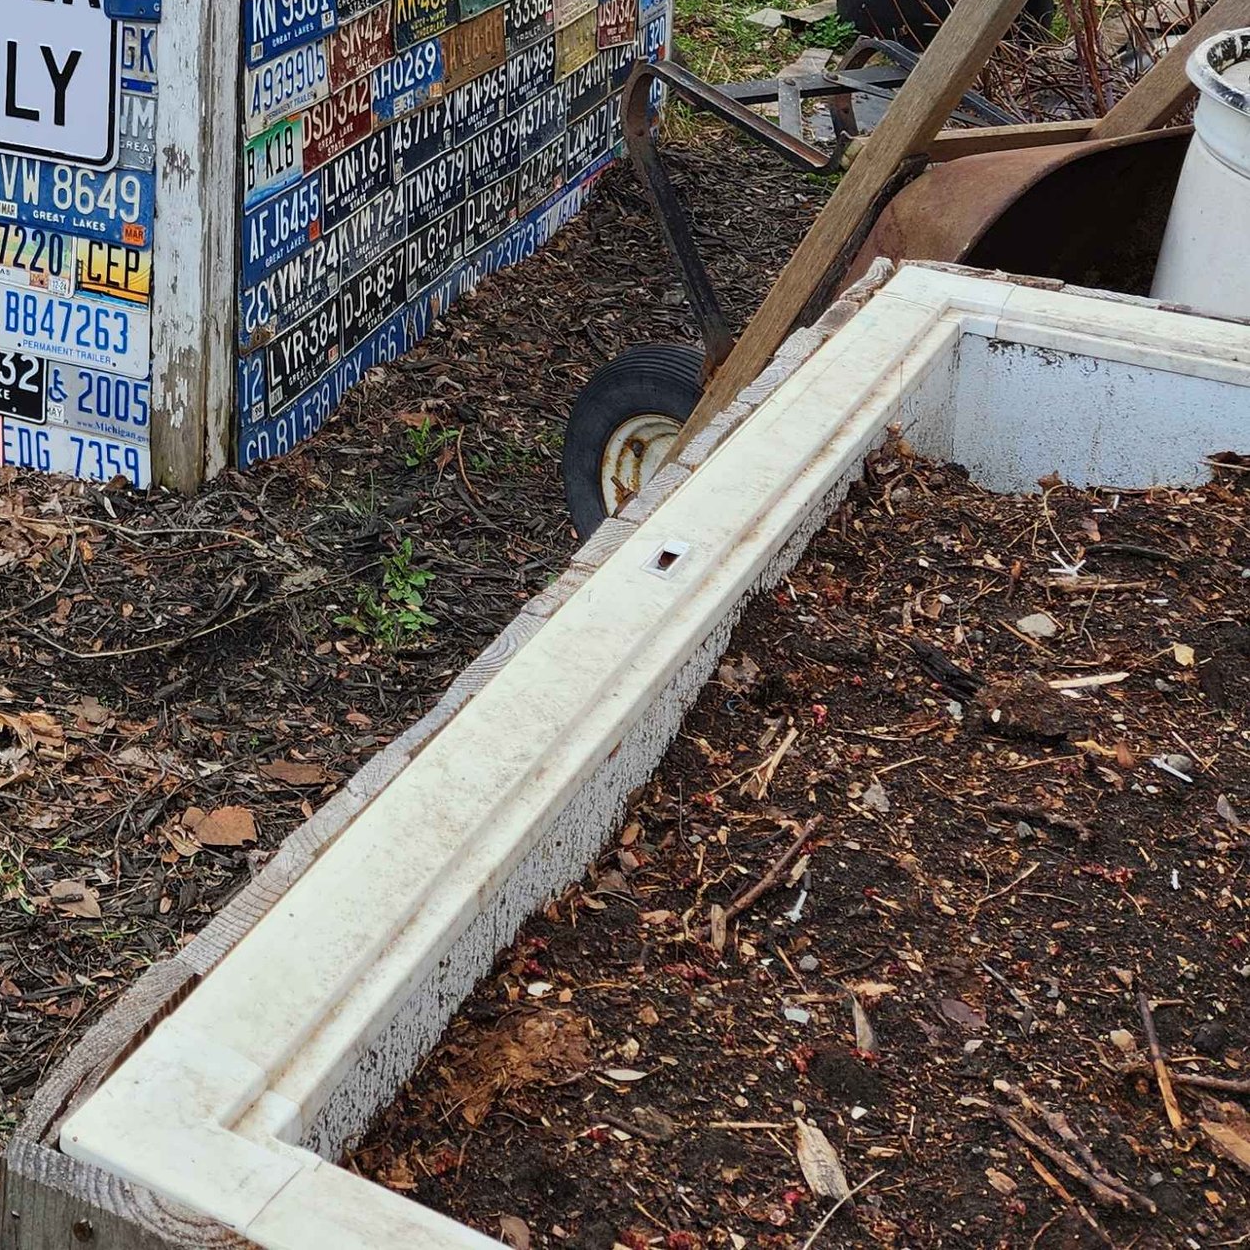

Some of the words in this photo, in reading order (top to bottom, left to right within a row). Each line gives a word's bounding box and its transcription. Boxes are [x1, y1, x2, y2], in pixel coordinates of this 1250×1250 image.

[272, 33, 291, 48] GREAT
[294, 24, 314, 40] LAKES
[318, 135, 335, 151] GREAT
[338, 124, 353, 140] LAKE
[327, 141, 346, 157] STATE
[0, 154, 41, 206] VW
[53, 164, 141, 224] 8649
[340, 190, 357, 207] GREAT
[359, 178, 375, 193] LAKE
[350, 194, 367, 211] STATE
[33, 210, 66, 224] GREAT
[73, 217, 106, 232] LAKES
[87, 241, 140, 288] CEP
[265, 250, 284, 267] GREAT
[286, 235, 306, 257] LAKES
[284, 297, 303, 316] GREAT
[305, 281, 322, 302] LAKE
[293, 301, 314, 320] STATE
[358, 309, 376, 328] GREAT
[378, 294, 392, 312] LAKE
[4, 290, 129, 355] B847263
[367, 314, 384, 331] STATE
[23, 339, 75, 357] PERMANENT
[76, 350, 112, 365] TRAILER
[289, 366, 308, 386] GREAT
[311, 350, 325, 371] LAKE
[299, 370, 318, 389] STATE
[78, 372, 148, 426] 2005
